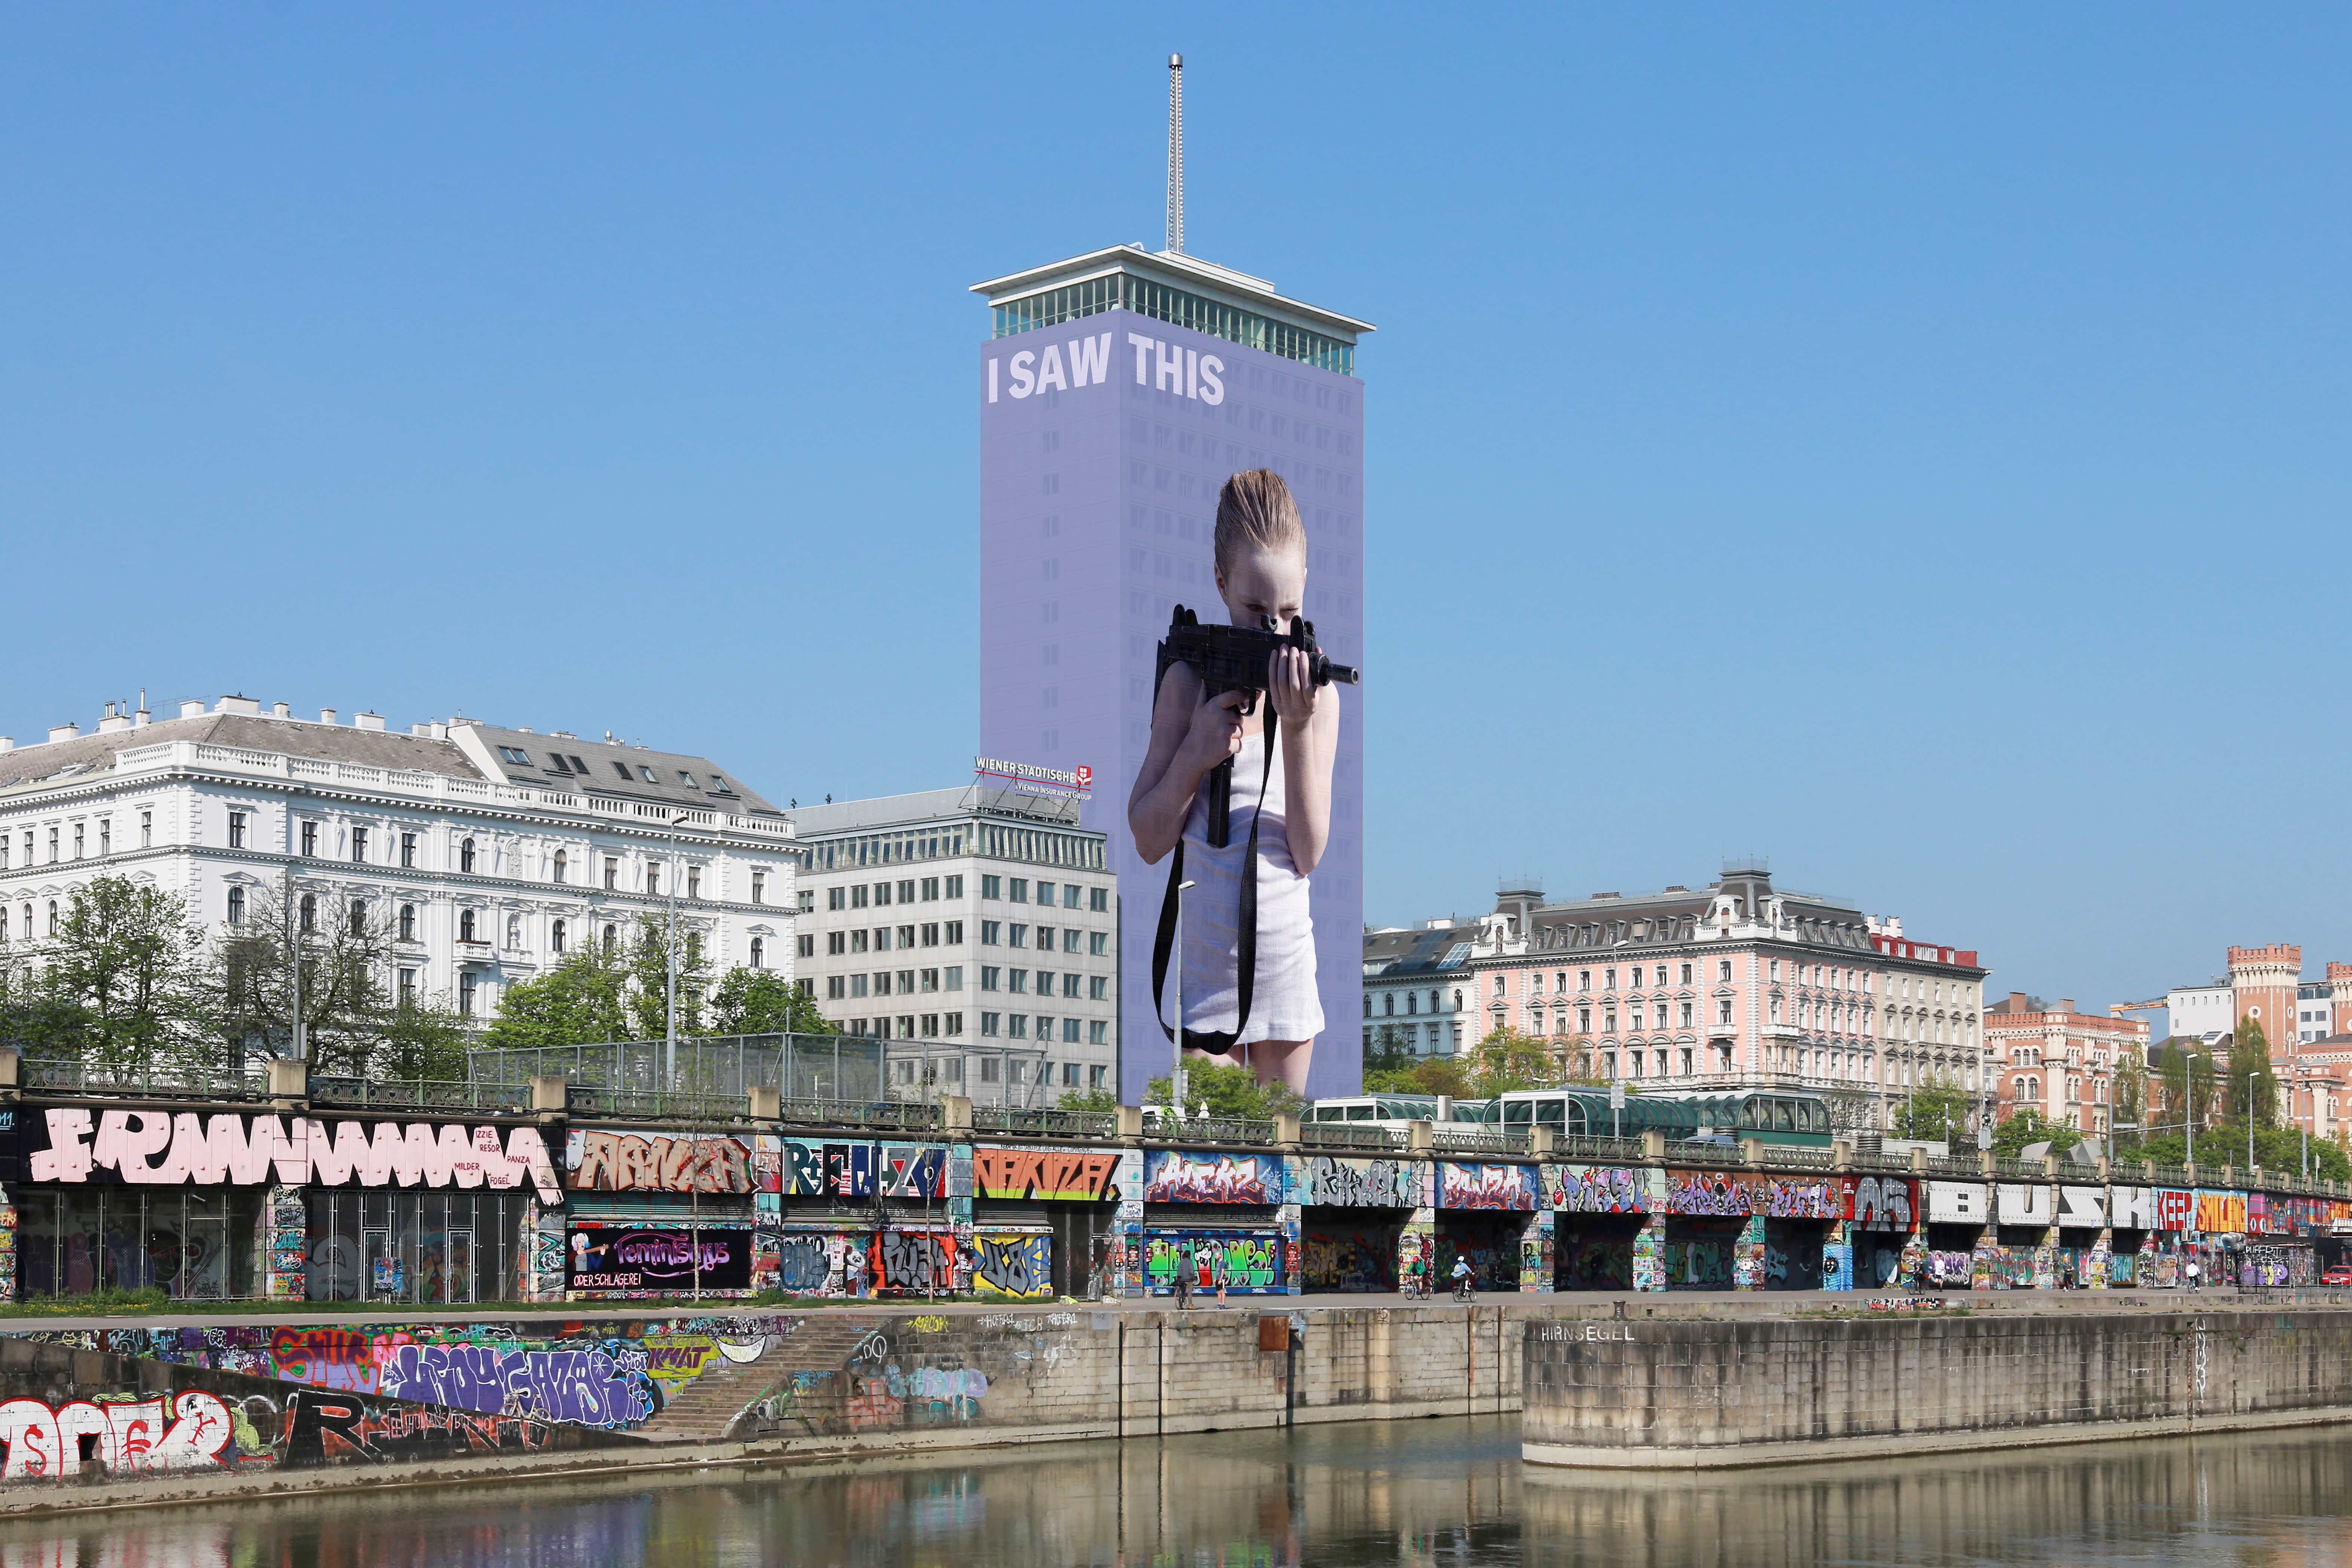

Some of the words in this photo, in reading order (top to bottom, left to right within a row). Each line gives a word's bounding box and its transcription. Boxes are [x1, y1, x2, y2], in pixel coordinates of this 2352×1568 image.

[989, 358, 998, 403] I
[1009, 332, 1112, 399] SAW
[1128, 332, 1224, 405] THIS
[975, 756, 1016, 773] WIENER
[1017, 764, 1077, 783] STÄDTISCHE
[480, 1144, 501, 1152] RESOR
[454, 1162, 480, 1171] MILDER
[507, 1156, 530, 1164] PANZA
[2158, 1191, 2192, 1231] KEEP
[2195, 1193, 2246, 1233] SMILING
[613, 1232, 730, 1271] Feminismus
[595, 1272, 641, 1286] SCHLÄGEREI
[1541, 1325, 1635, 1341] HIRNSEGEL
[454, 1415, 471, 1429] BUT
[478, 1418, 490, 1432] NO
